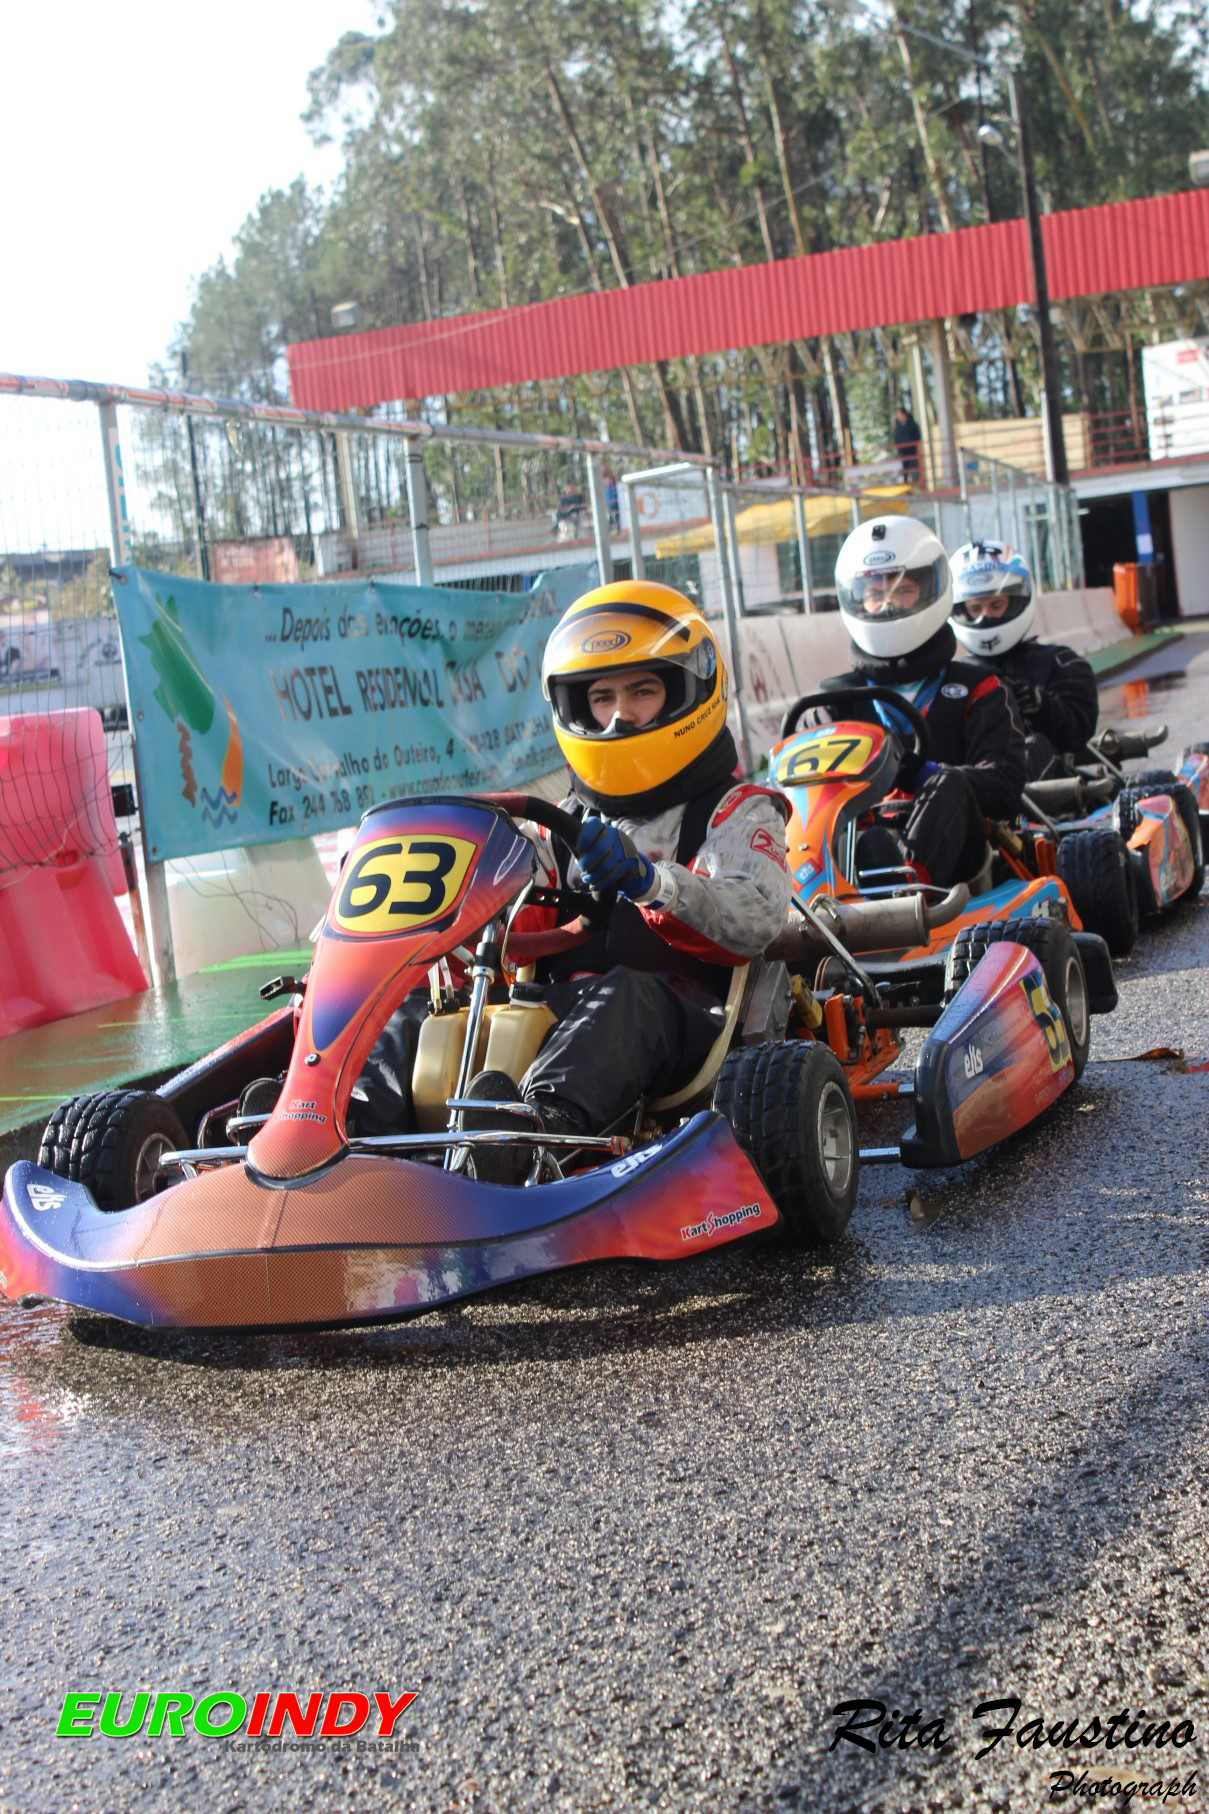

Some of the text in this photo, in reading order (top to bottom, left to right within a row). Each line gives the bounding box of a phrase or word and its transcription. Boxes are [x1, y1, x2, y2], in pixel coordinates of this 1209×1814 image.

[269, 664, 353, 722] HOTEL
[673, 721, 696, 739] NUNO
[696, 706, 711, 725] CRUZ
[373, 746, 390, 771] do
[446, 738, 454, 760] 4
[787, 738, 861, 778] 67
[269, 799, 296, 827] Fax
[303, 792, 326, 820] 244
[338, 841, 457, 919] 63
[289, 1099, 317, 1110] Kart
